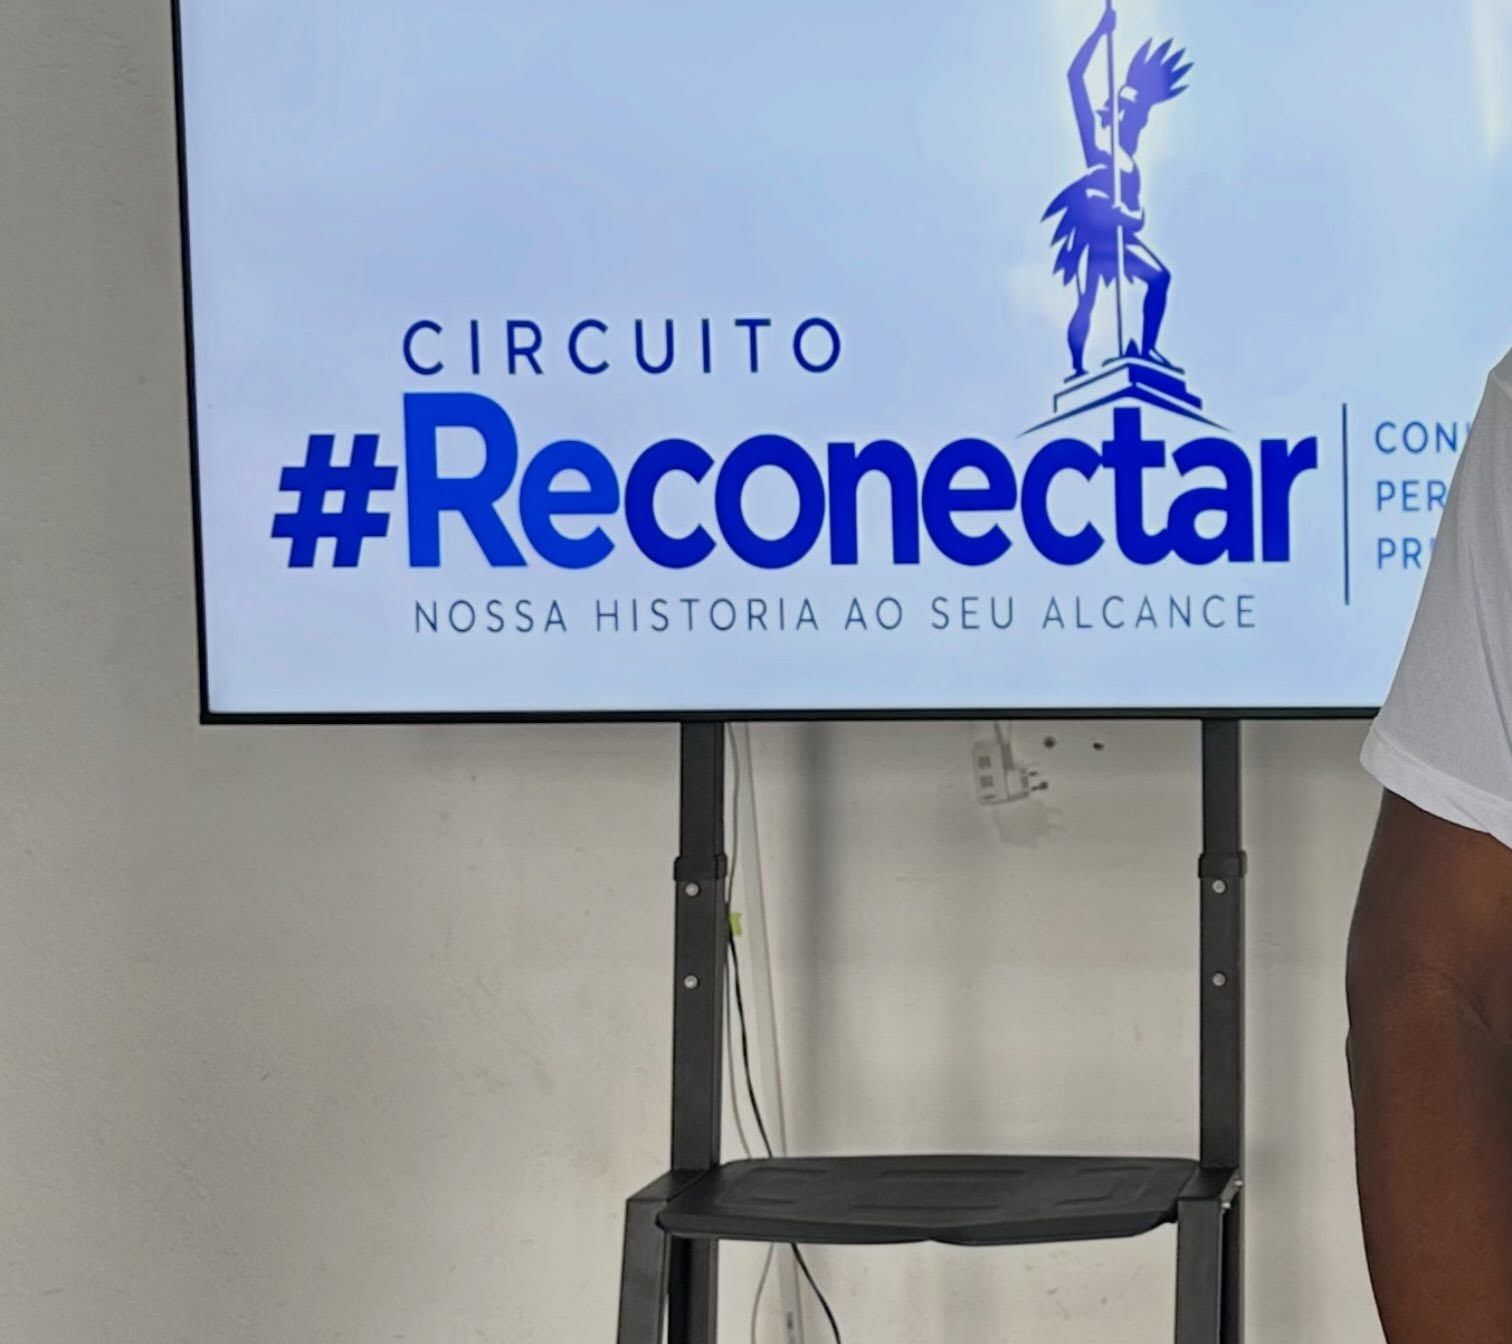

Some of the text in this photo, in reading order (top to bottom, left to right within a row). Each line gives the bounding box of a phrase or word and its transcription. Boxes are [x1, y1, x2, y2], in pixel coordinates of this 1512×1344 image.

[402, 317, 841, 376] CIRCUITO
[1374, 420, 1471, 455] CON
[270, 391, 1319, 570] #Reconectar
[415, 594, 1256, 634] NOSSA HISTORIA AO SEU ALCANCE
